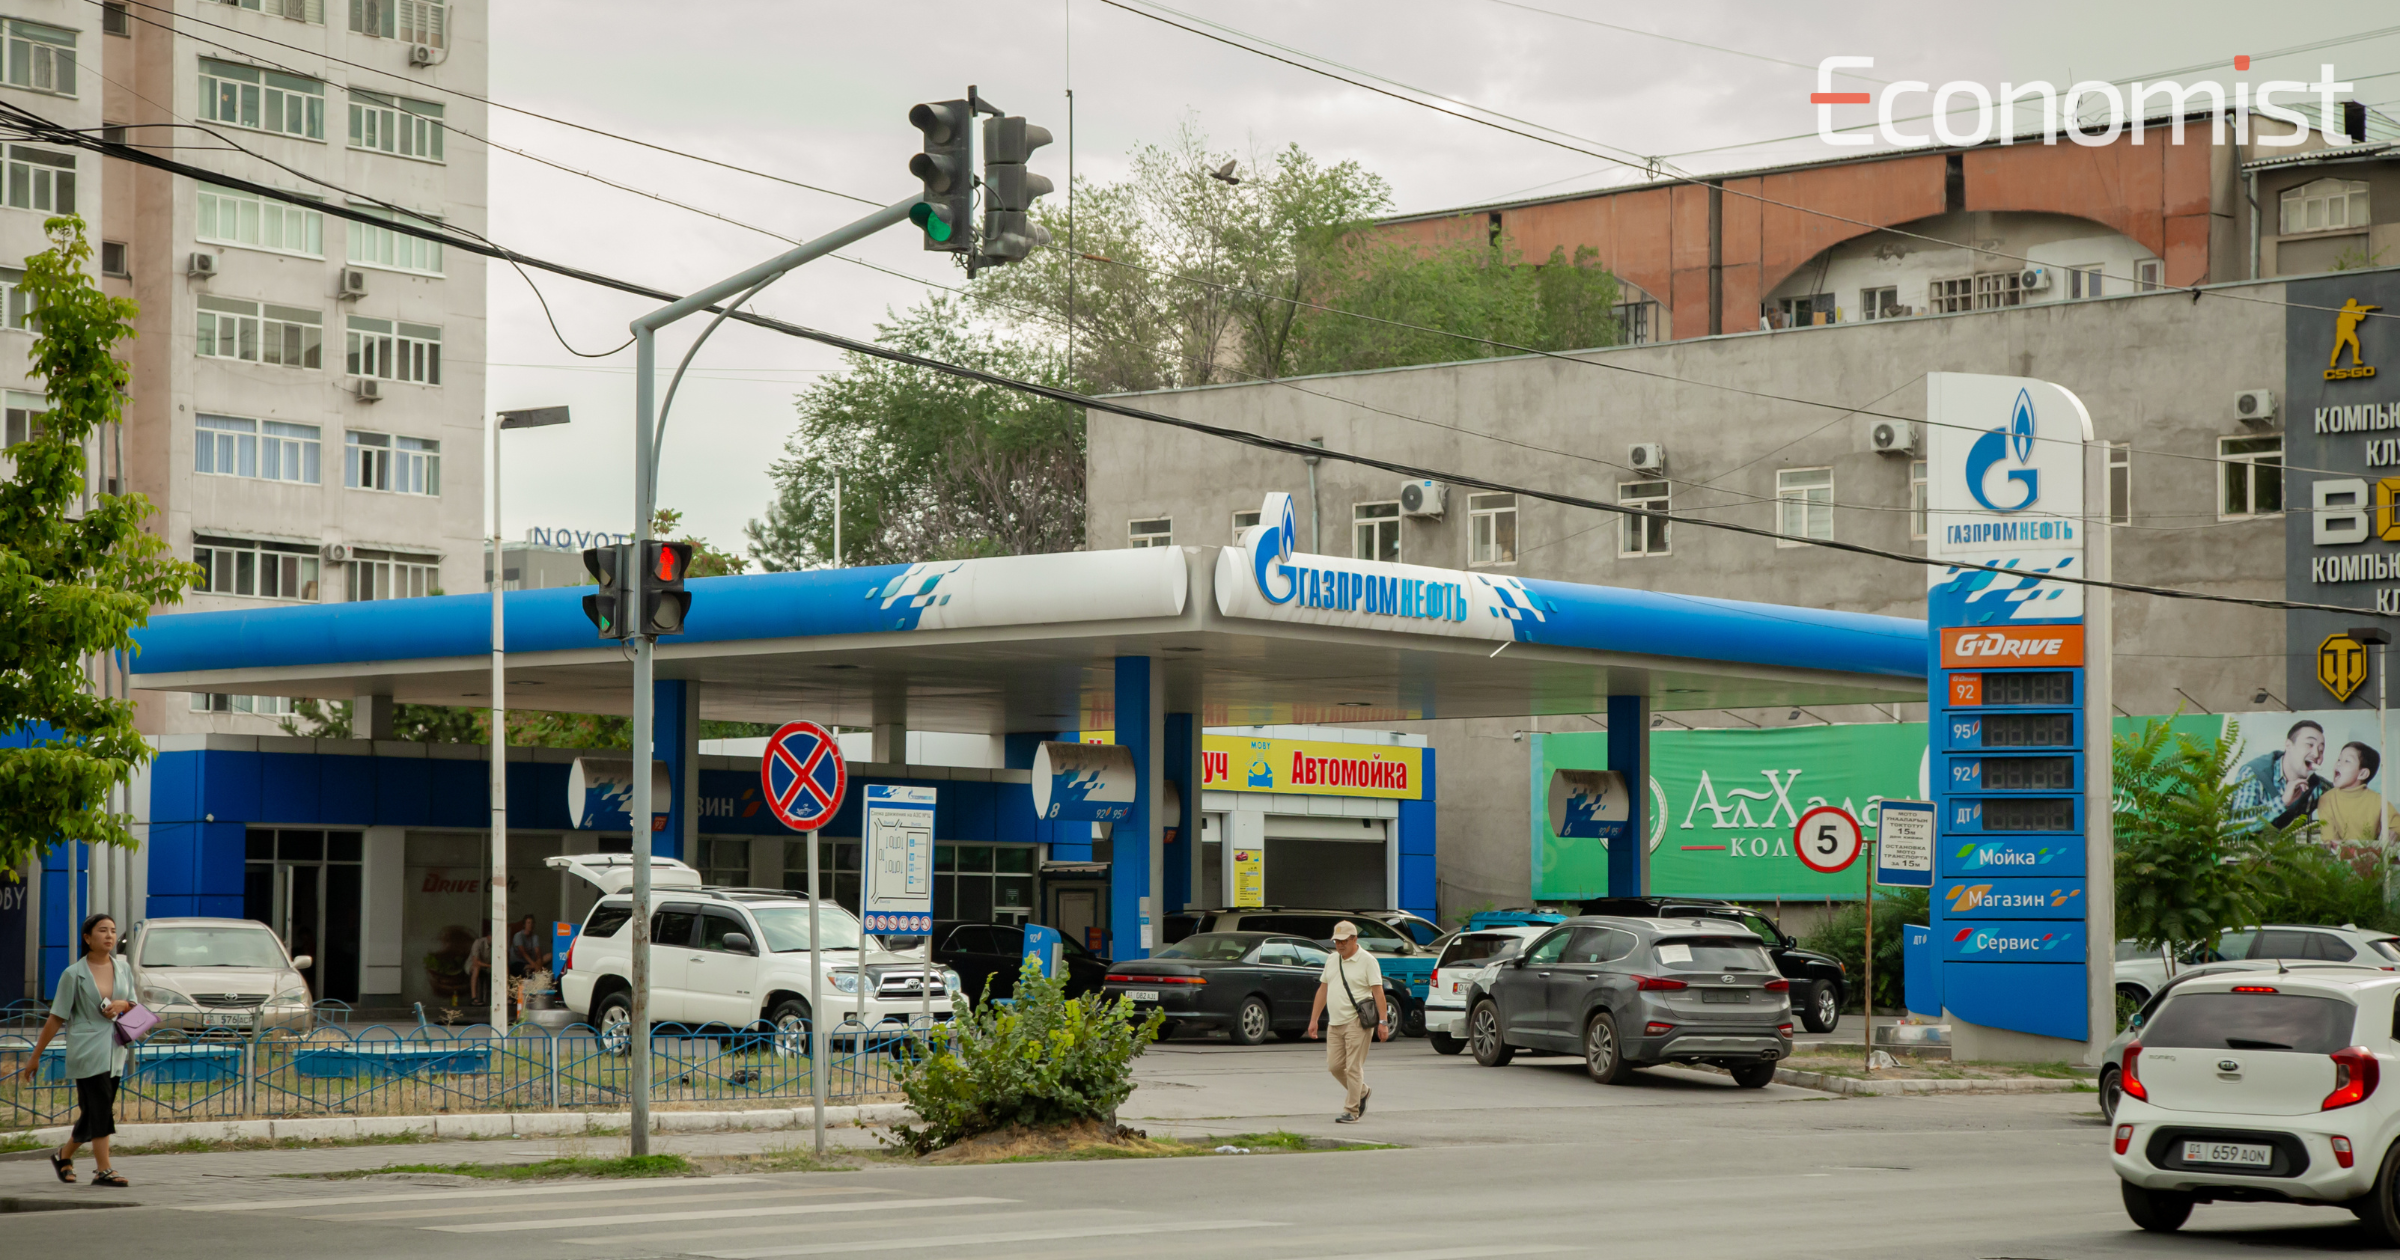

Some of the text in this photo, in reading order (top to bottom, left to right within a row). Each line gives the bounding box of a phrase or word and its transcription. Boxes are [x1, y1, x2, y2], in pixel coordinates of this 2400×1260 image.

[2323, 366, 2375, 380] CS:GO
[533, 526, 635, 549] NOVOT
[1947, 521, 2073, 544] ГАЗПРОМНЕФТЬ
[1297, 567, 1467, 622] ГАЗПРОМНЕФТЬ
[1956, 684, 1974, 699] 92
[1953, 724, 1971, 739] 95
[1250, 741, 1271, 750] MOBY
[1291, 751, 1407, 790] Автомойка
[1953, 766, 1971, 781] 92
[1049, 802, 1061, 818] 8
[1095, 808, 1122, 819] 92 95
[1956, 808, 1971, 824] ДТ
[584, 813, 594, 827] 4
[1564, 822, 1572, 836] 6
[1816, 825, 1838, 855] 5
[1979, 849, 2036, 865] Мойка
[1968, 890, 2045, 907] Магазин
[868, 918, 873, 927] 5
[1029, 934, 1037, 943] 92
[1976, 933, 2040, 953] Сервис
[2212, 1145, 2239, 1161] 659
[2241, 1149, 2266, 1163] AON
